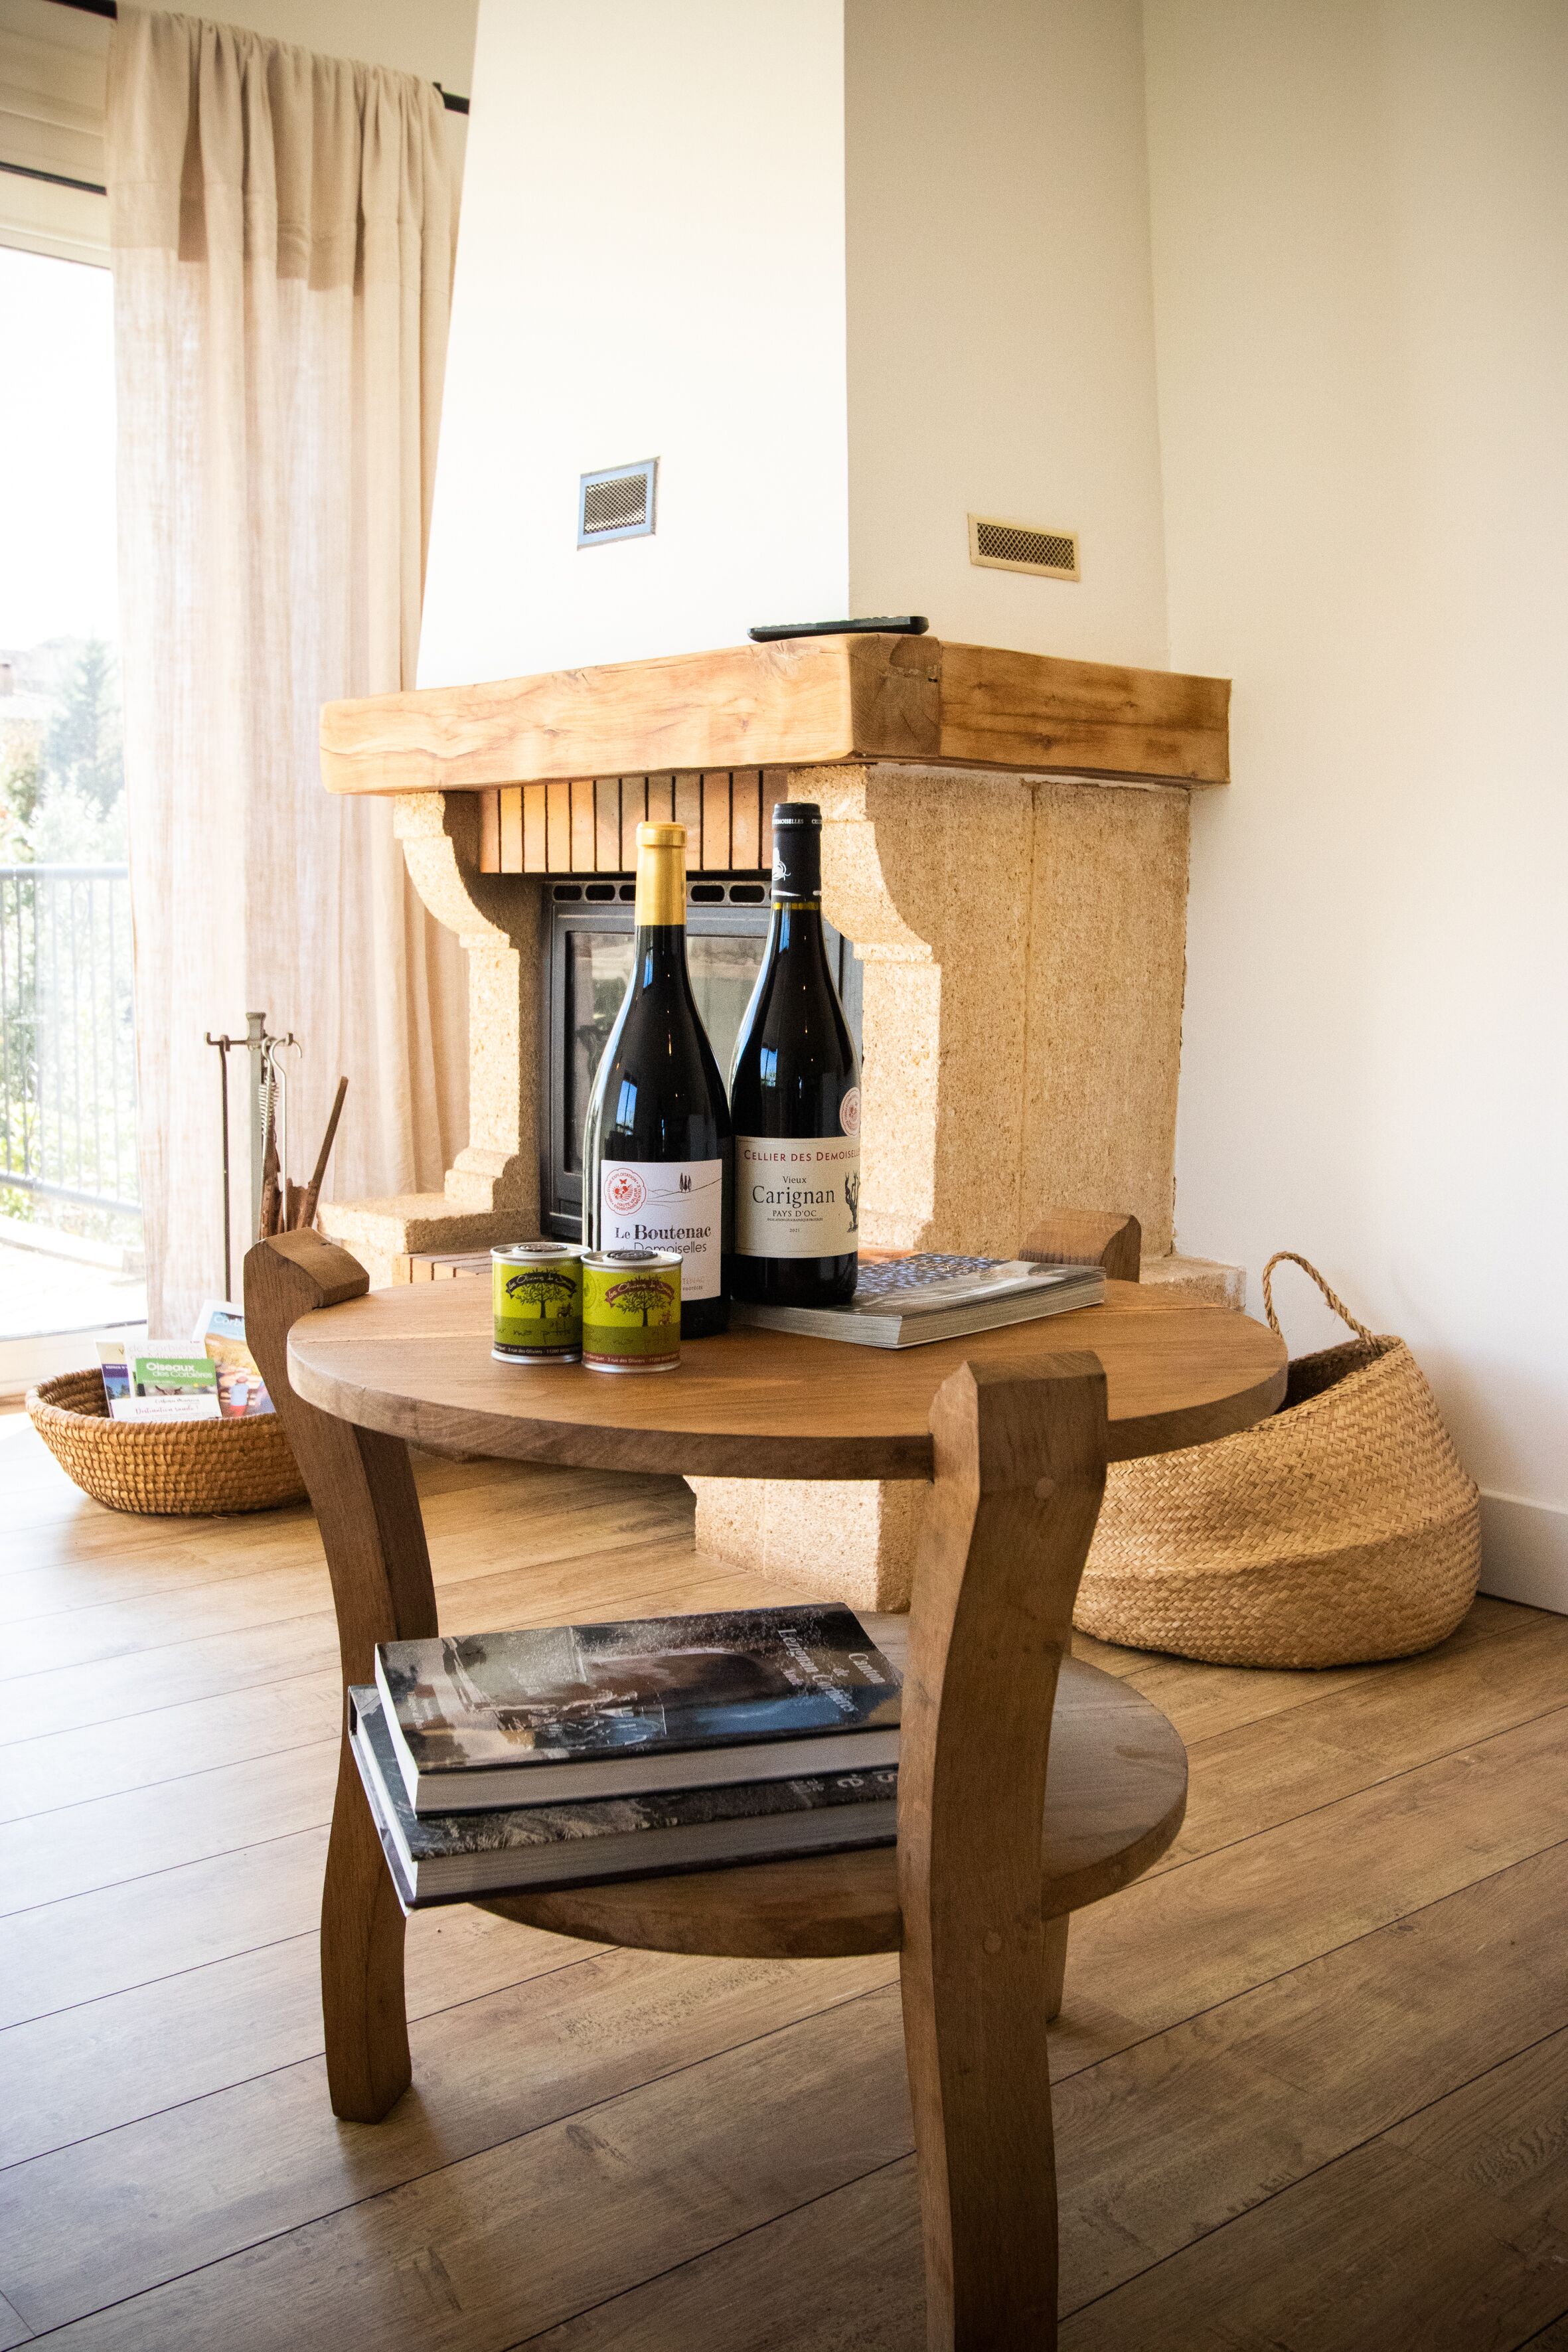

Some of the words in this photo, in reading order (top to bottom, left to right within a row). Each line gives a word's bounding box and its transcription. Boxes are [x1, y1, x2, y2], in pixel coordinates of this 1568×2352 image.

[744, 1150, 786, 1162] CELLIER
[791, 1153, 812, 1162] DES
[752, 1185, 835, 1209] Carignan
[615, 1227, 631, 1239] Le
[633, 1224, 712, 1240] Boutenac
[146, 1362, 195, 1372] Oiseaux
[778, 1628, 819, 1673] Lézignan
[848, 1652, 886, 1684] Canton
